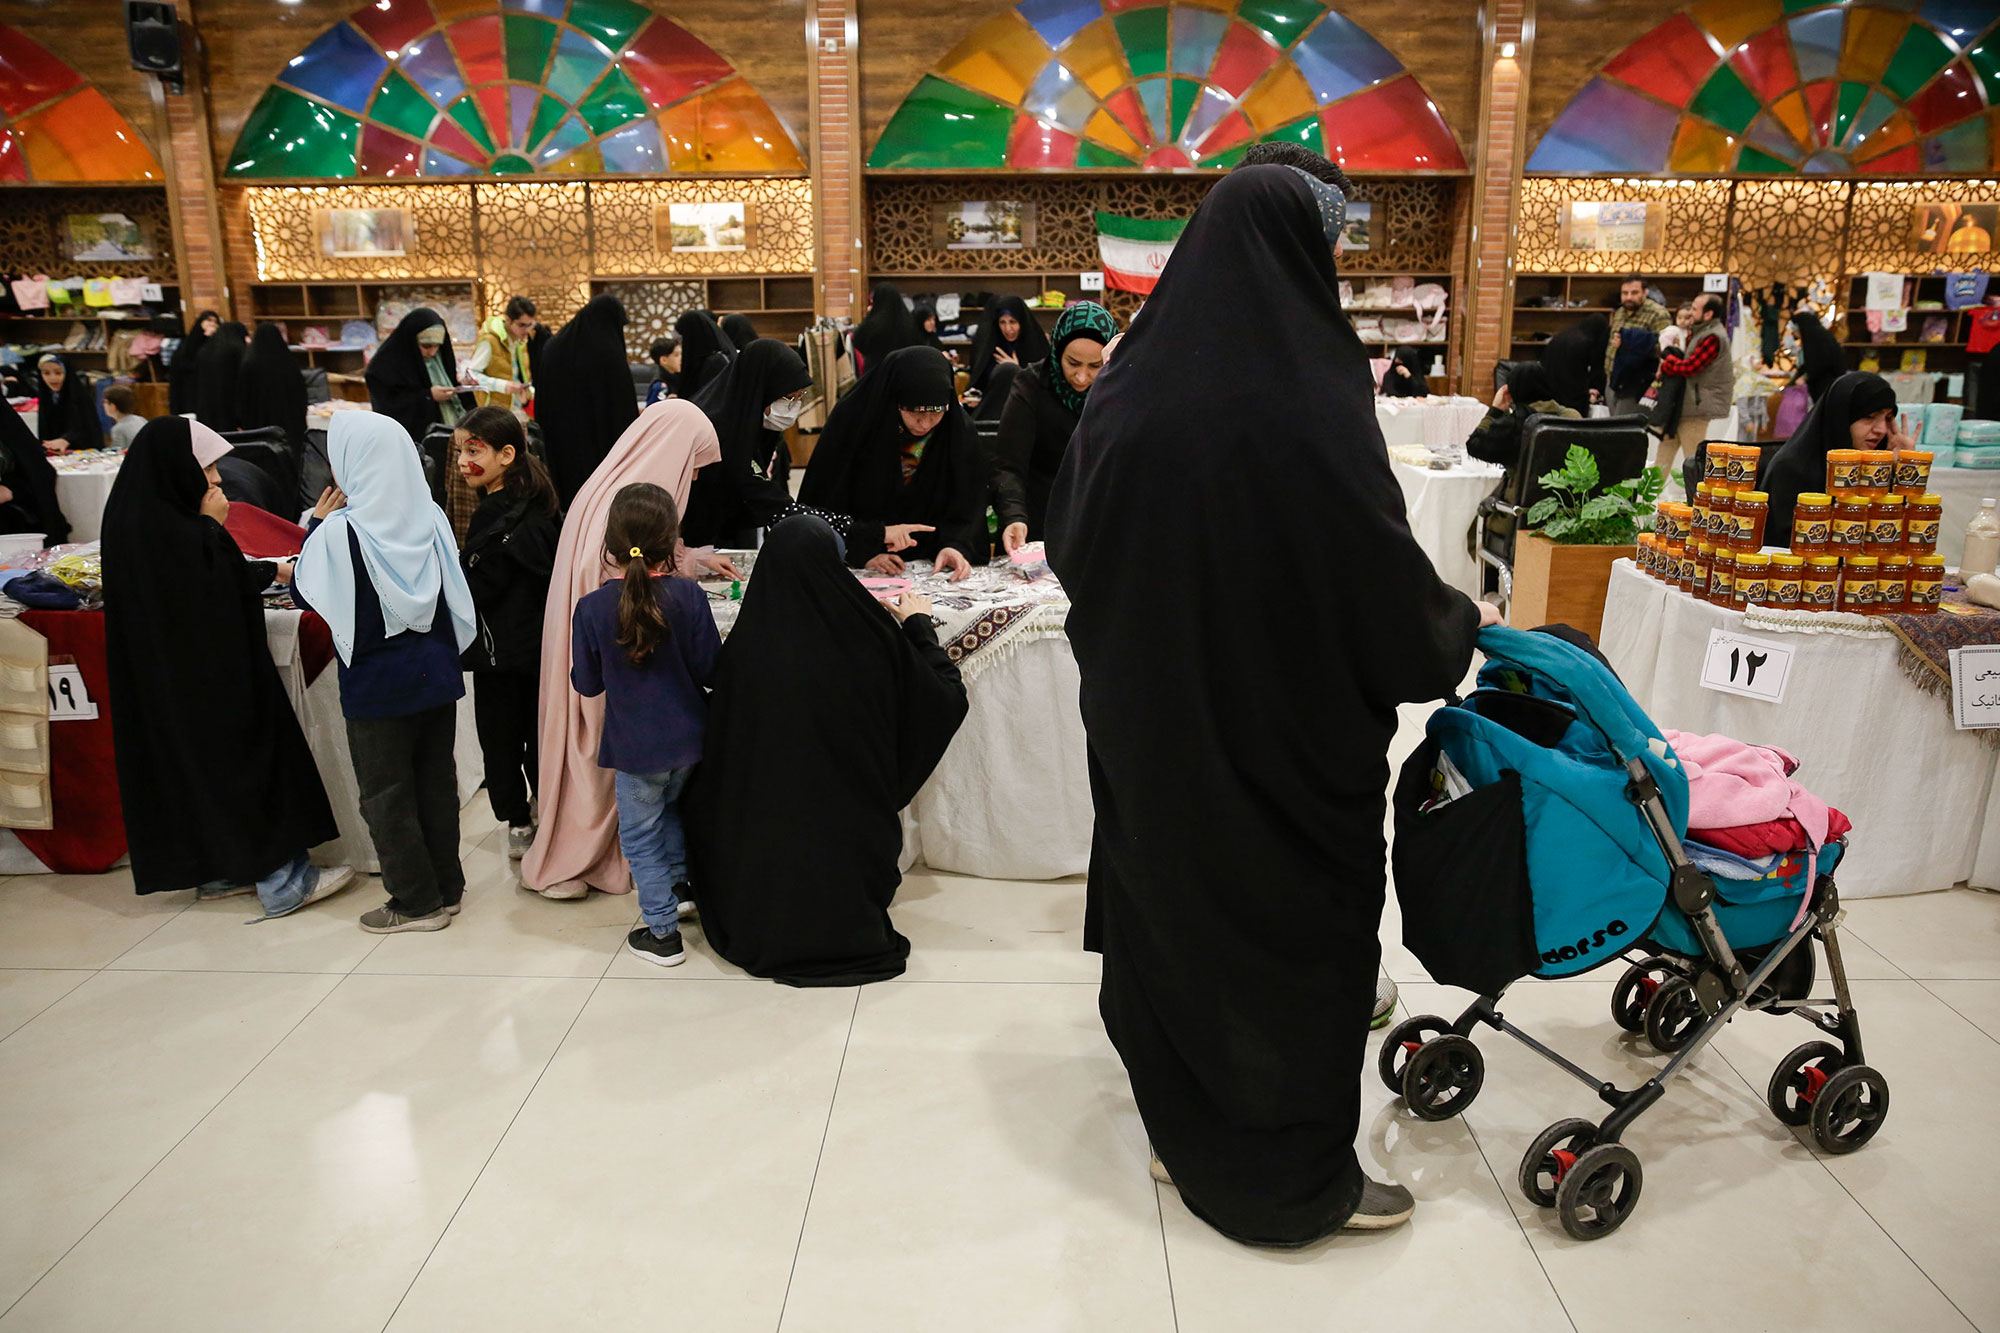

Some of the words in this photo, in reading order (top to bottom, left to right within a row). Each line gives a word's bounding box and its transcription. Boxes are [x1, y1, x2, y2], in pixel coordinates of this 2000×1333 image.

[1730, 647, 1768, 686] ۱۲
[48, 677, 76, 711] ۱۹
[1971, 693, 2000, 710] انیک
[1541, 919, 1629, 965] dorsa
